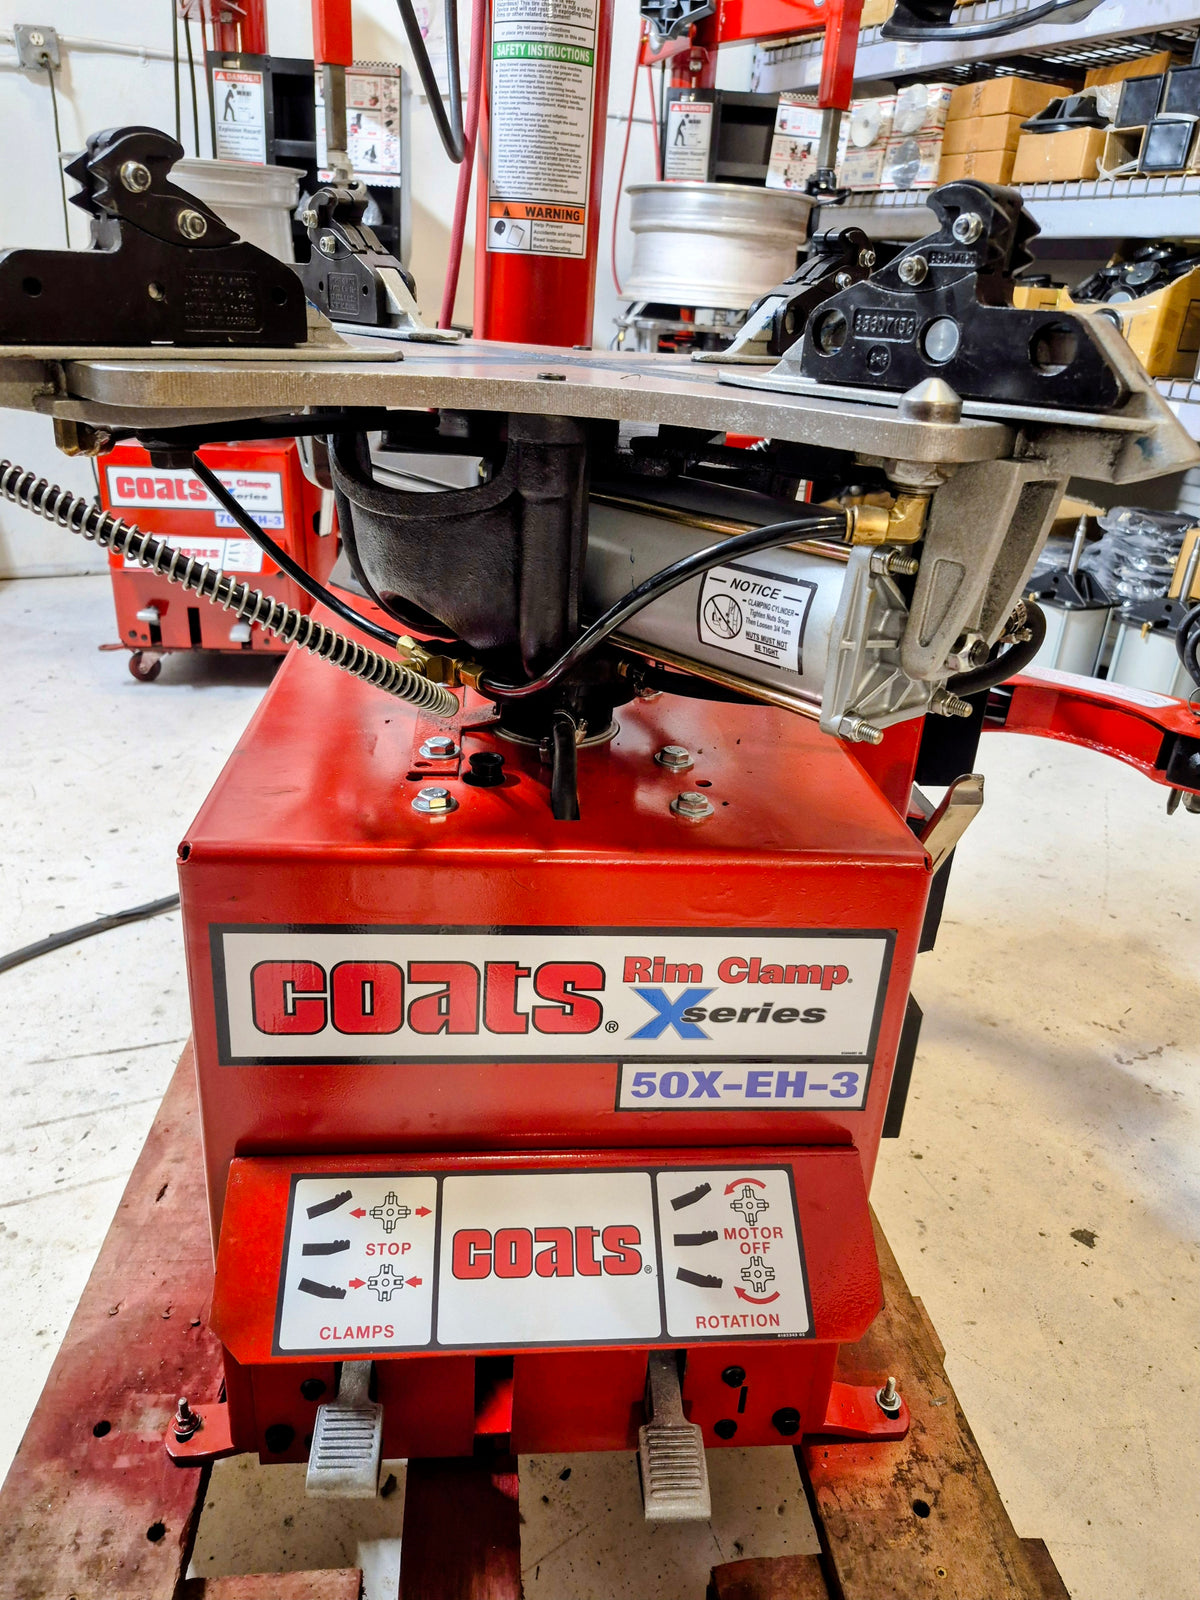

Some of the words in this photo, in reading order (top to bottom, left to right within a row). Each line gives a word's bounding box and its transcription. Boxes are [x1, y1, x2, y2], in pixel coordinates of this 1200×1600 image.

[496, 44, 526, 56] SAFETY
[528, 44, 590, 63] INSTRUCTIONS
[525, 206, 580, 221] WARNING
[236, 479, 271, 490] Clamp
[730, 578, 782, 600] NOTICE
[748, 598, 772, 612] CLAMPING
[772, 605, 794, 616] CYLINDER
[746, 617, 756, 625] Then
[756, 620, 773, 631] Loosen
[780, 627, 792, 636] Turn
[750, 608, 766, 620] Tighten
[767, 614, 778, 622] Nuts
[778, 617, 790, 627] Snug
[746, 630, 760, 642] NUTS
[760, 635, 776, 645] MUST
[776, 640, 788, 649] NOT
[762, 647, 778, 657] TIGHT
[622, 956, 703, 983] Rim
[718, 956, 847, 990] Clamp
[631, 1070, 860, 1099] 50X-EH-3
[724, 1226, 783, 1240] MOTOR
[366, 1242, 412, 1256] STOP
[740, 1242, 770, 1254] OFF
[320, 1324, 394, 1340] CLAMPS
[696, 1314, 780, 1329] ROTATION
